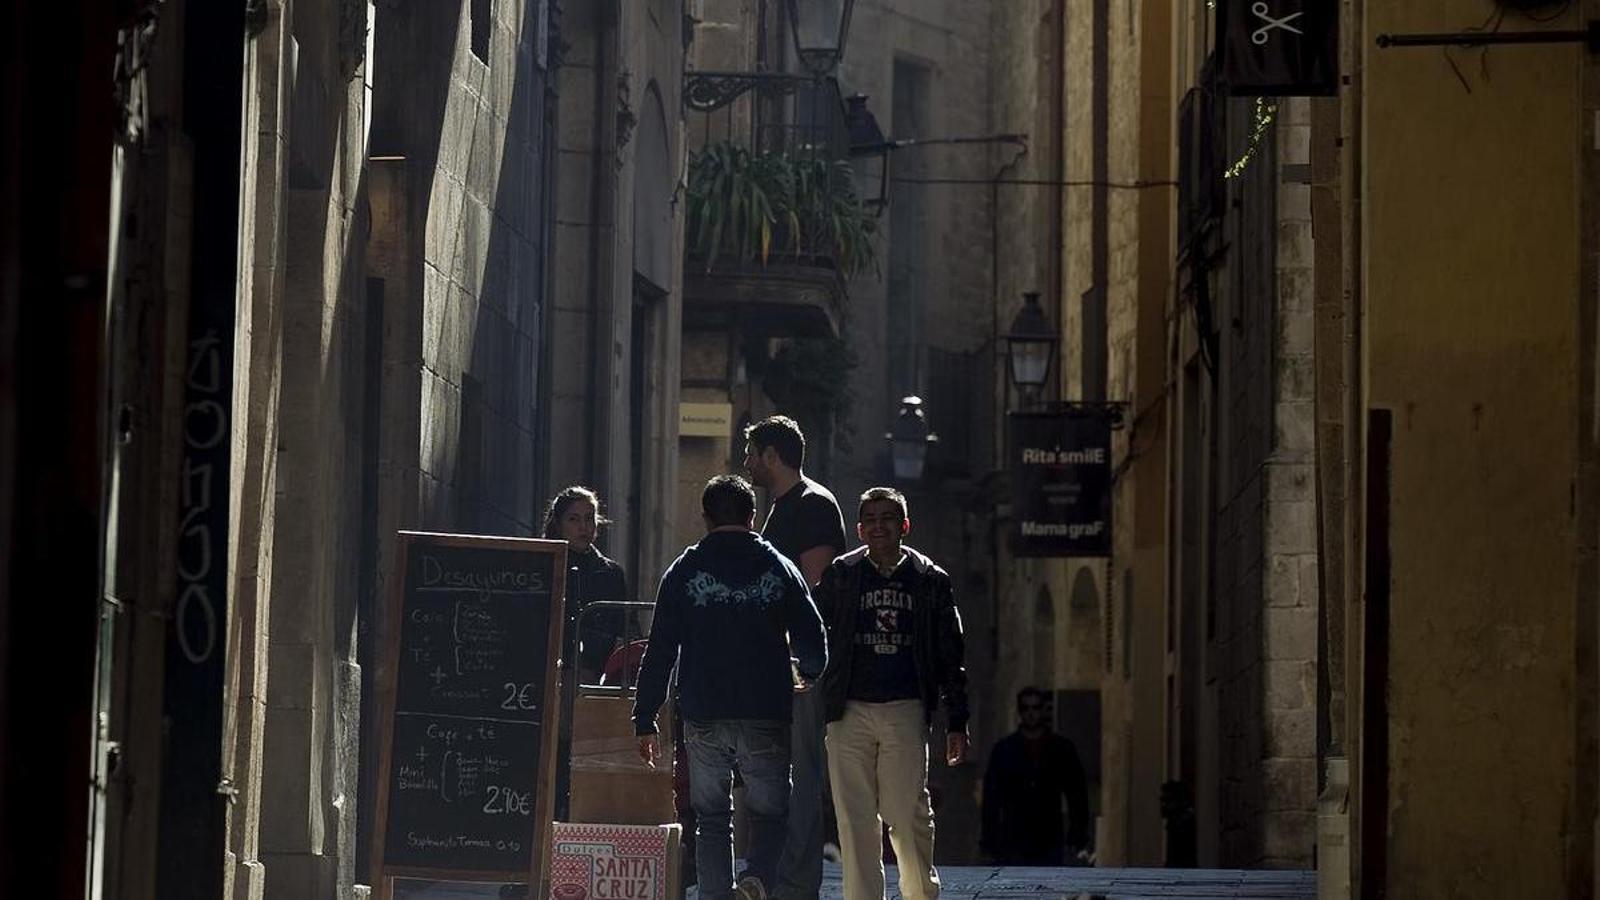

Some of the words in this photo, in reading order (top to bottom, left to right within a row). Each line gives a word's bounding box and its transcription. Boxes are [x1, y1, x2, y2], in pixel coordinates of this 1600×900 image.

[500, 681, 537, 710] 2€
[562, 845, 610, 854] Dulces
[595, 857, 652, 878] SANTA
[596, 879, 648, 898] CRUZ
